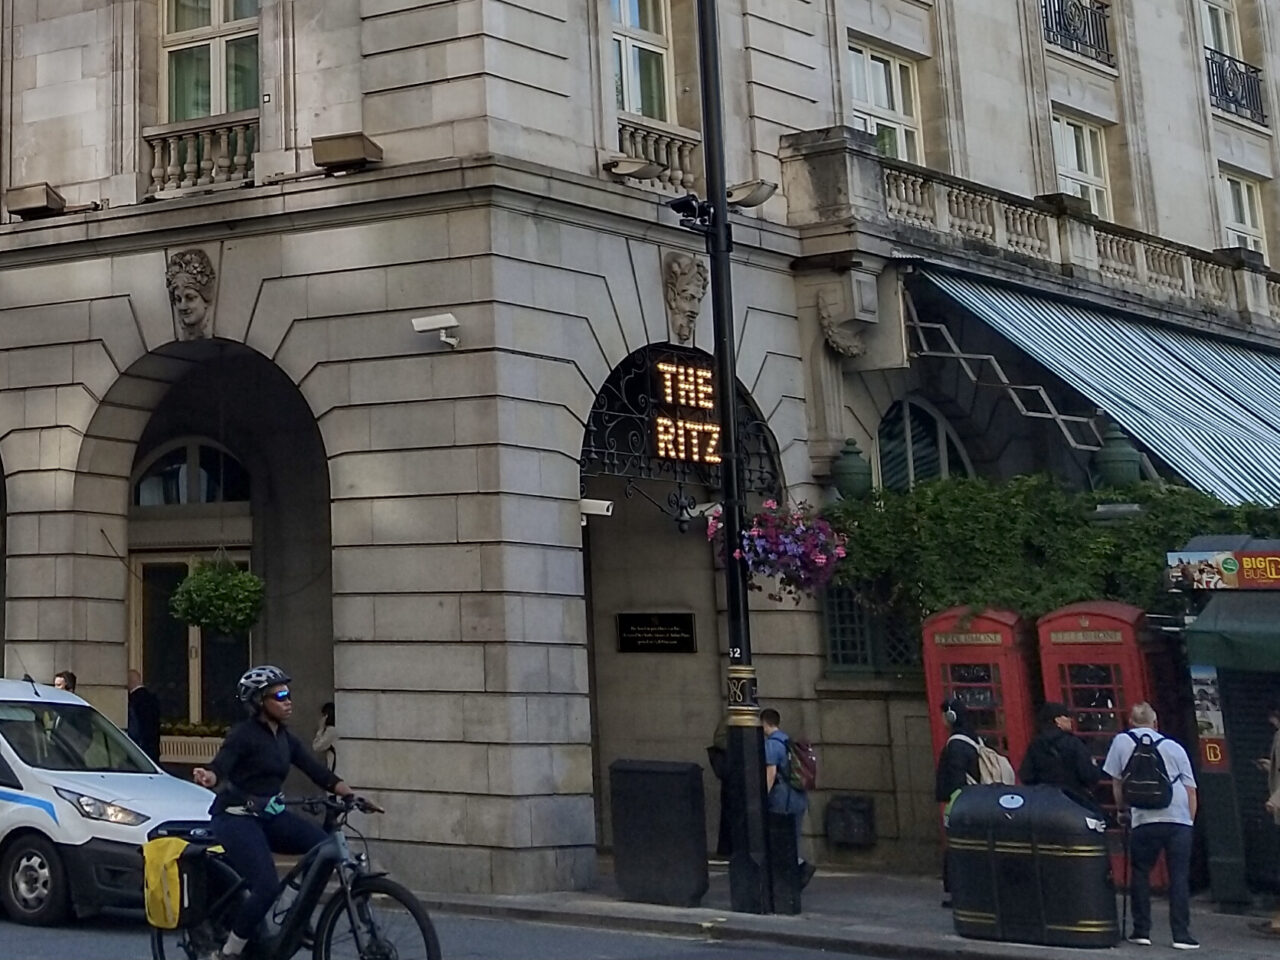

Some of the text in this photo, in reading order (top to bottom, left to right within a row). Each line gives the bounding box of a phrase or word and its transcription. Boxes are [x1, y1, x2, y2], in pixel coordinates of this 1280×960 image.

[657, 362, 713, 409] THE
[657, 417, 721, 463] RITZ
[1242, 557, 1265, 569] BIG
[1244, 568, 1267, 579] BUS
